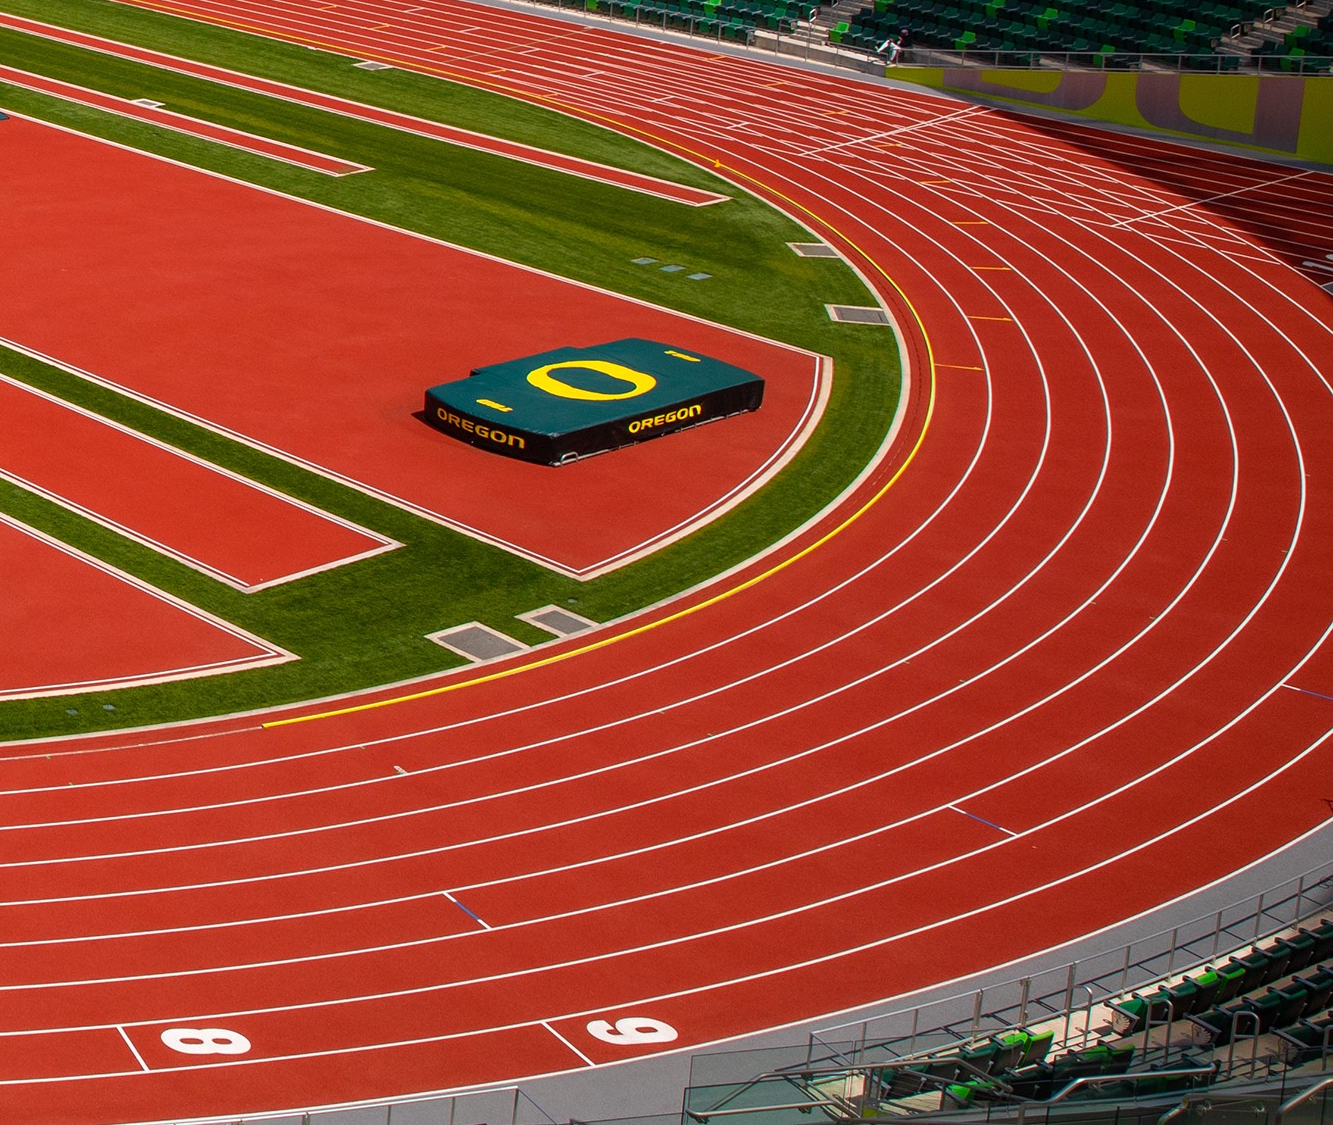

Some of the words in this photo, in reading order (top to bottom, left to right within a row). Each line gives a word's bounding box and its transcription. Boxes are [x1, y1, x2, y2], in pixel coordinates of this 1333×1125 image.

[528, 361, 655, 400] O
[436, 407, 526, 450] OREGON
[628, 404, 702, 434] OREGON
[160, 1027, 252, 1055] 8
[586, 1016, 679, 1046] 9
